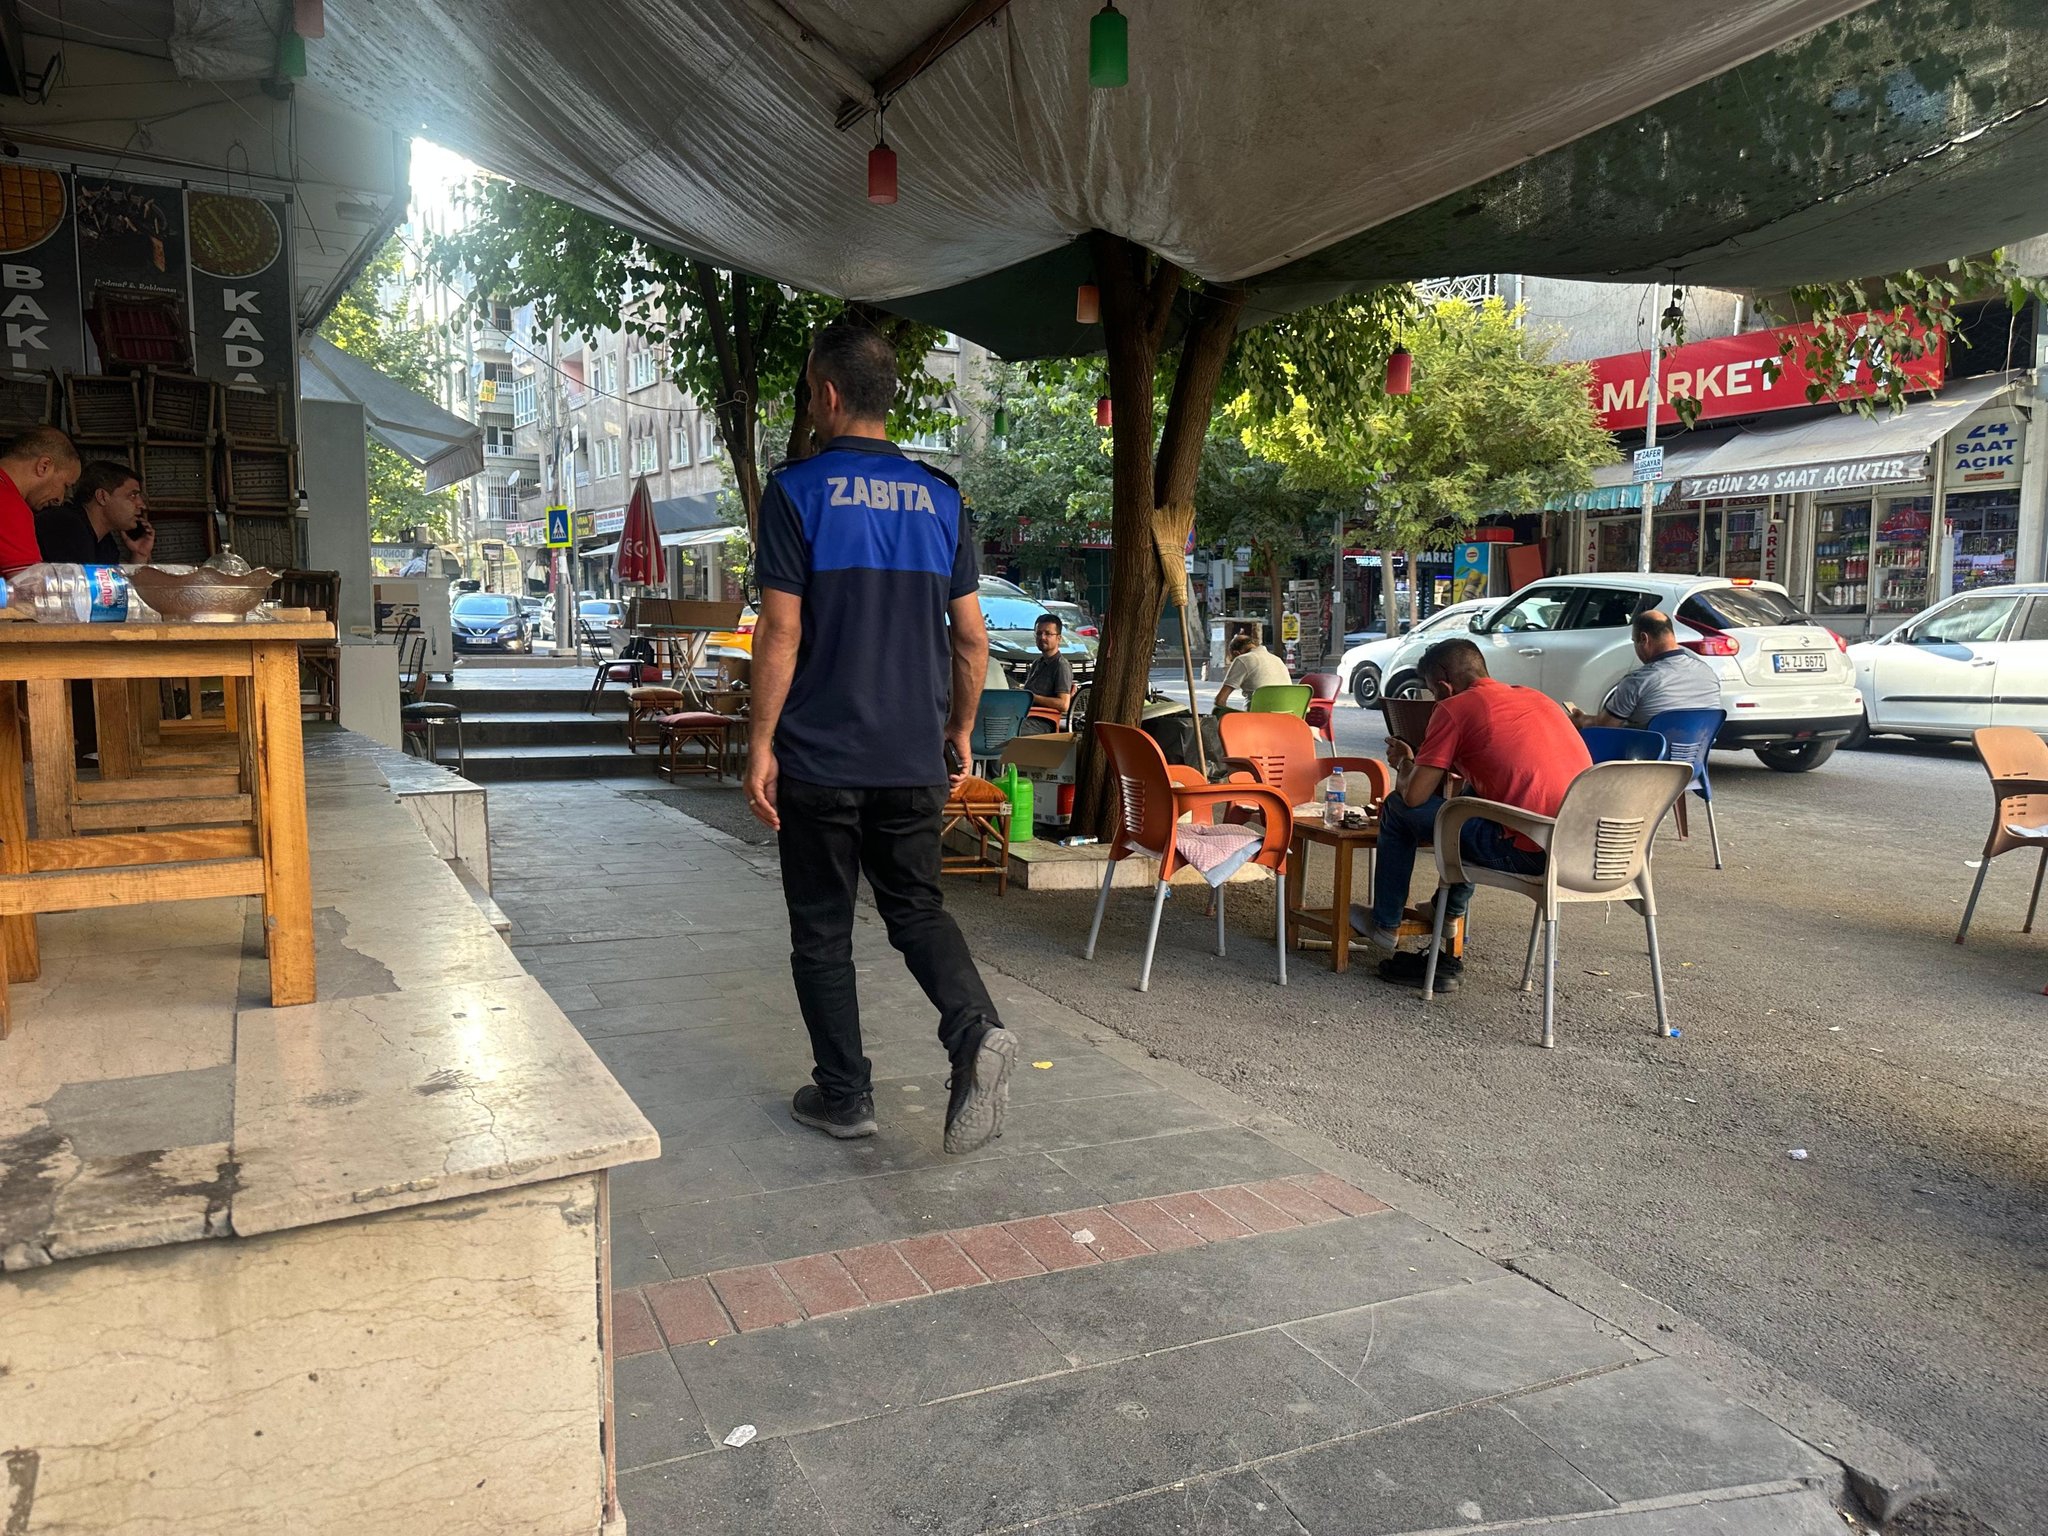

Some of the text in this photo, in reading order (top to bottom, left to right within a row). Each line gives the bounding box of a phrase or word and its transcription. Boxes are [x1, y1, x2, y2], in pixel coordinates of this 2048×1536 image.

[1602, 355, 1783, 413] MARKET
[1955, 438, 2018, 455] SAAT
[1955, 454, 2014, 471] AÇIK
[1691, 480, 1703, 496] 7
[1706, 474, 1743, 494] GÜN
[1748, 476, 1770, 491] 24
[1773, 468, 1820, 488] SAAT
[1823, 460, 1905, 489] AÇIKTIR
[827, 476, 936, 514] ZABITA
[1779, 656, 1790, 668] 34
[1793, 656, 1802, 667] ZJ
